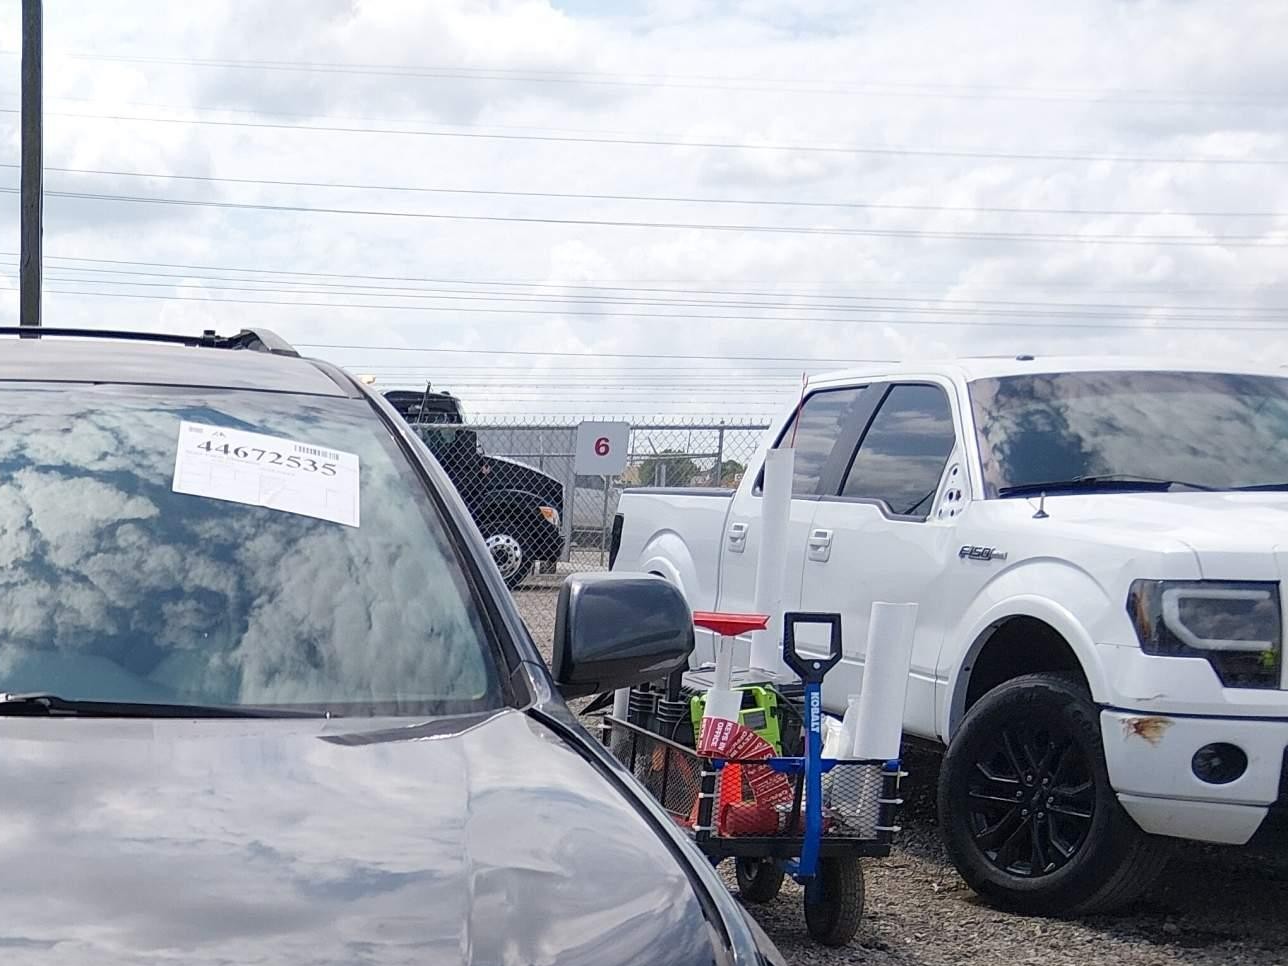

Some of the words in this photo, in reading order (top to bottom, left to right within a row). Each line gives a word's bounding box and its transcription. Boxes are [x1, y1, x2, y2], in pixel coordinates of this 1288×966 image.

[594, 436, 610, 457] 6
[197, 440, 337, 477] 44672535
[810, 691, 820, 733] KOBALT
[711, 722, 724, 747] OFFICE
[722, 722, 733, 741] KEYS
[717, 741, 726, 751] IN
